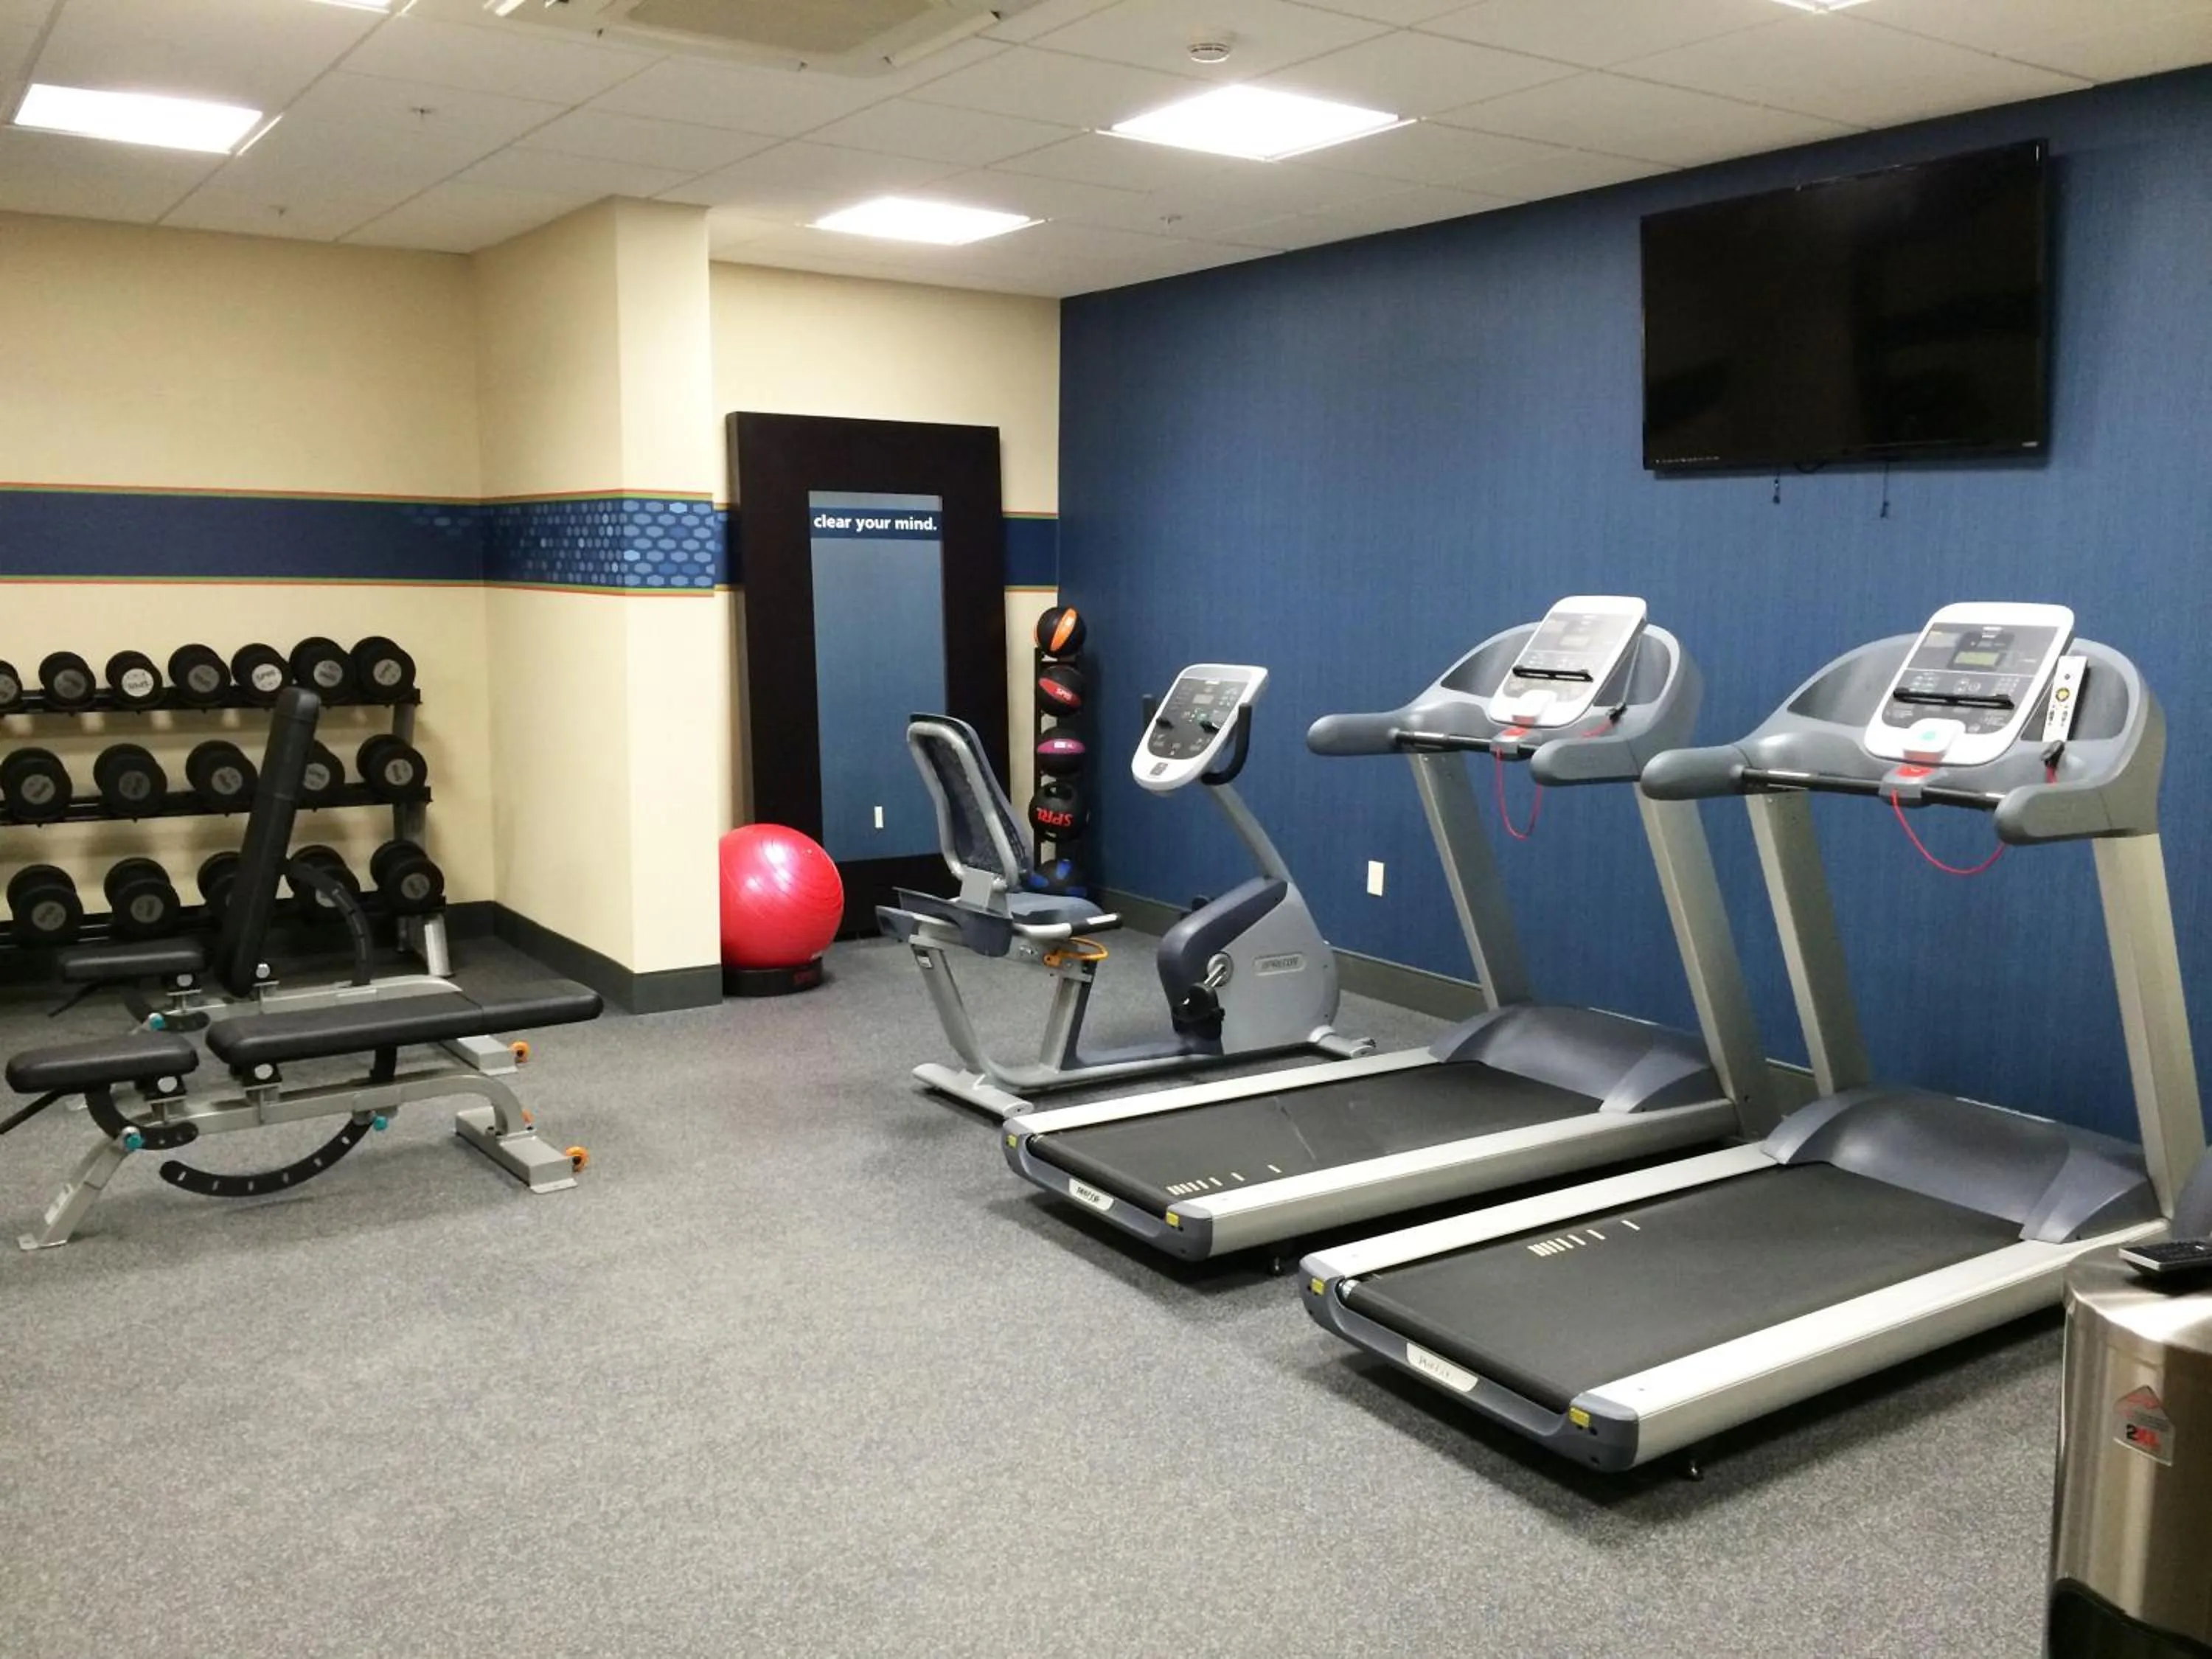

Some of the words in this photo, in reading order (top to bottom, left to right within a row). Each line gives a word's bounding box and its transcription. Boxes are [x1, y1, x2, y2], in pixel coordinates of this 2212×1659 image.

[813, 514, 852, 528] clear
[856, 518, 891, 532] your
[895, 517, 937, 530] mind.
